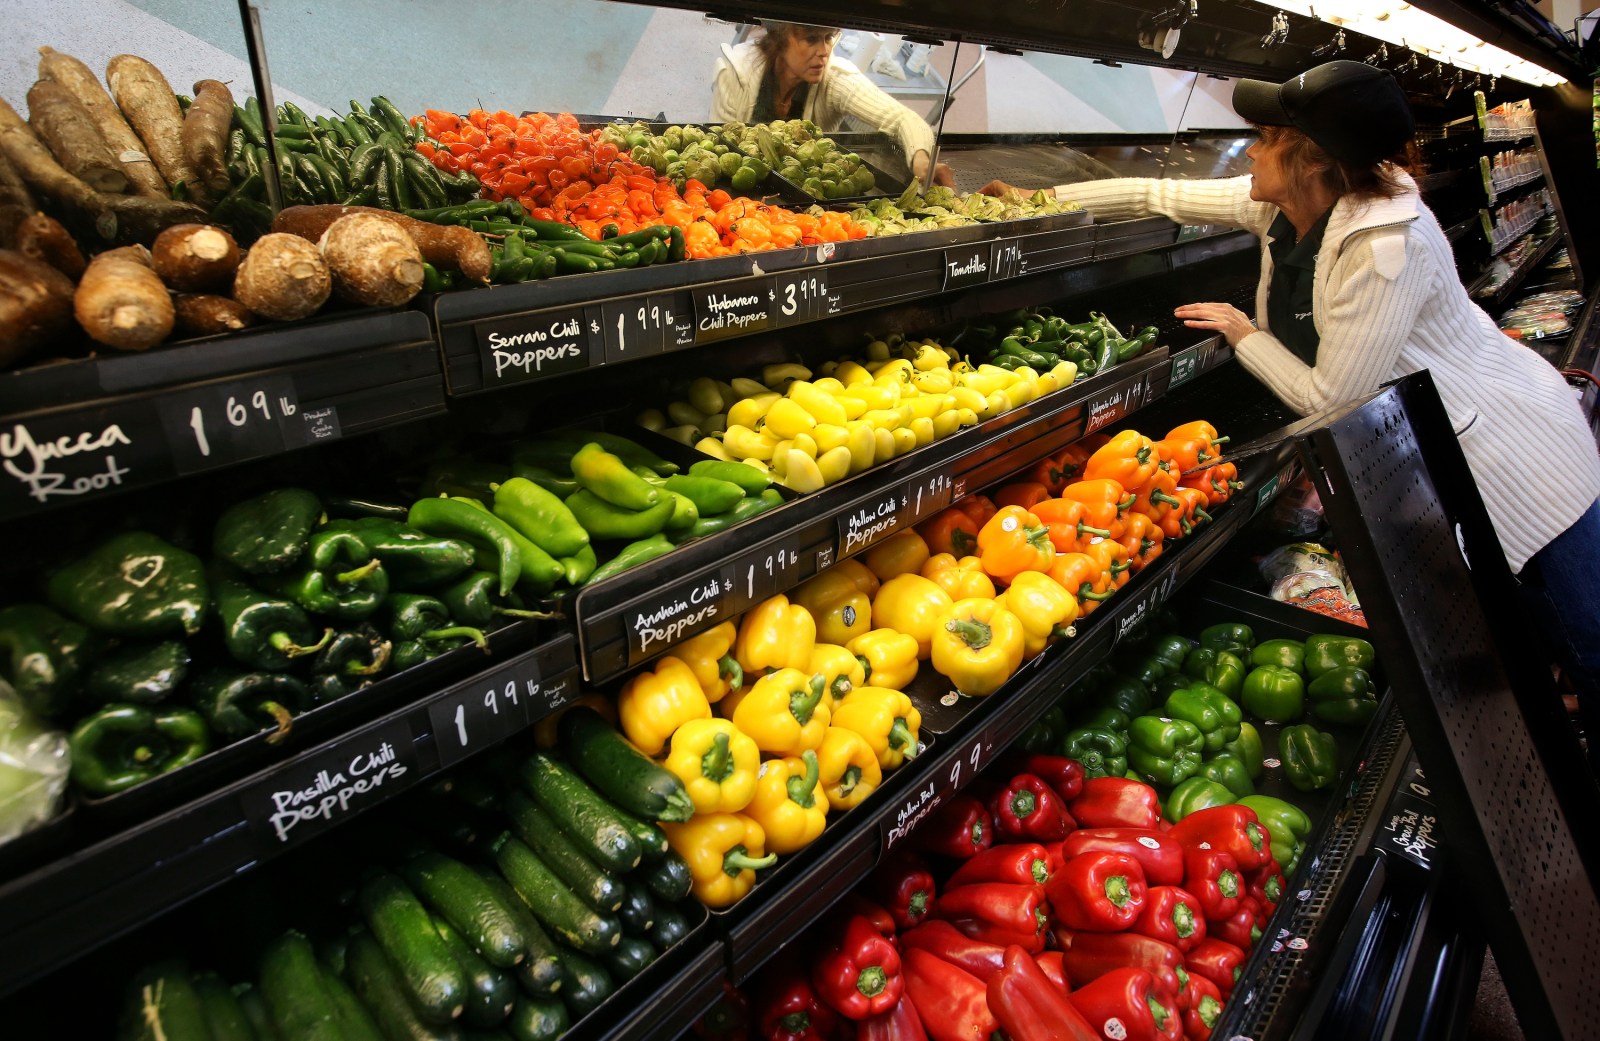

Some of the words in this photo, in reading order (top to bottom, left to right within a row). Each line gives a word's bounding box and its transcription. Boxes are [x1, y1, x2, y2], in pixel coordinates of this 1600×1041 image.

[948, 254, 987, 277] Tomatillos
[995, 249, 1001, 274] 1
[707, 293, 759, 313] Habanero
[768, 289, 776, 302] $
[820, 283, 827, 296] lb
[488, 331, 548, 350] Serrano
[550, 318, 580, 338] Chili
[590, 319, 600, 334] $
[617, 313, 625, 351] 1
[637, 305, 660, 330] 99
[665, 310, 674, 325] lb
[699, 312, 724, 331] Chili
[726, 311, 768, 328] Peppers
[493, 342, 581, 378] Peppers
[190, 406, 210, 456] 1
[226, 390, 271, 427] 69
[280, 397, 296, 416] lb
[303, 408, 331, 421] Product
[0, 424, 132, 480] Yucca
[24, 455, 131, 502] Root
[916, 486, 922, 516] 1
[845, 516, 897, 553] Peppers
[849, 509, 876, 534] Yellow
[877, 497, 896, 516] Chili
[724, 578, 732, 592] $
[747, 564, 754, 599] 1
[765, 549, 785, 576] 99
[790, 551, 797, 565] lb
[634, 600, 688, 631] Anaheim
[690, 579, 719, 604] Chili
[639, 604, 717, 653] Peppers
[455, 704, 467, 746] 1
[484, 681, 518, 714] 99
[527, 679, 539, 696] lb
[271, 770, 347, 814] Pasilla
[349, 742, 396, 776] Chili
[269, 763, 408, 841] Peppers
[888, 796, 941, 849] Peppers
[898, 801, 920, 828] Yellow
[920, 782, 935, 804] Bell
[1392, 827, 1414, 846] Green
[1403, 809, 1419, 826] Bell
[1404, 815, 1438, 862] Peppers
